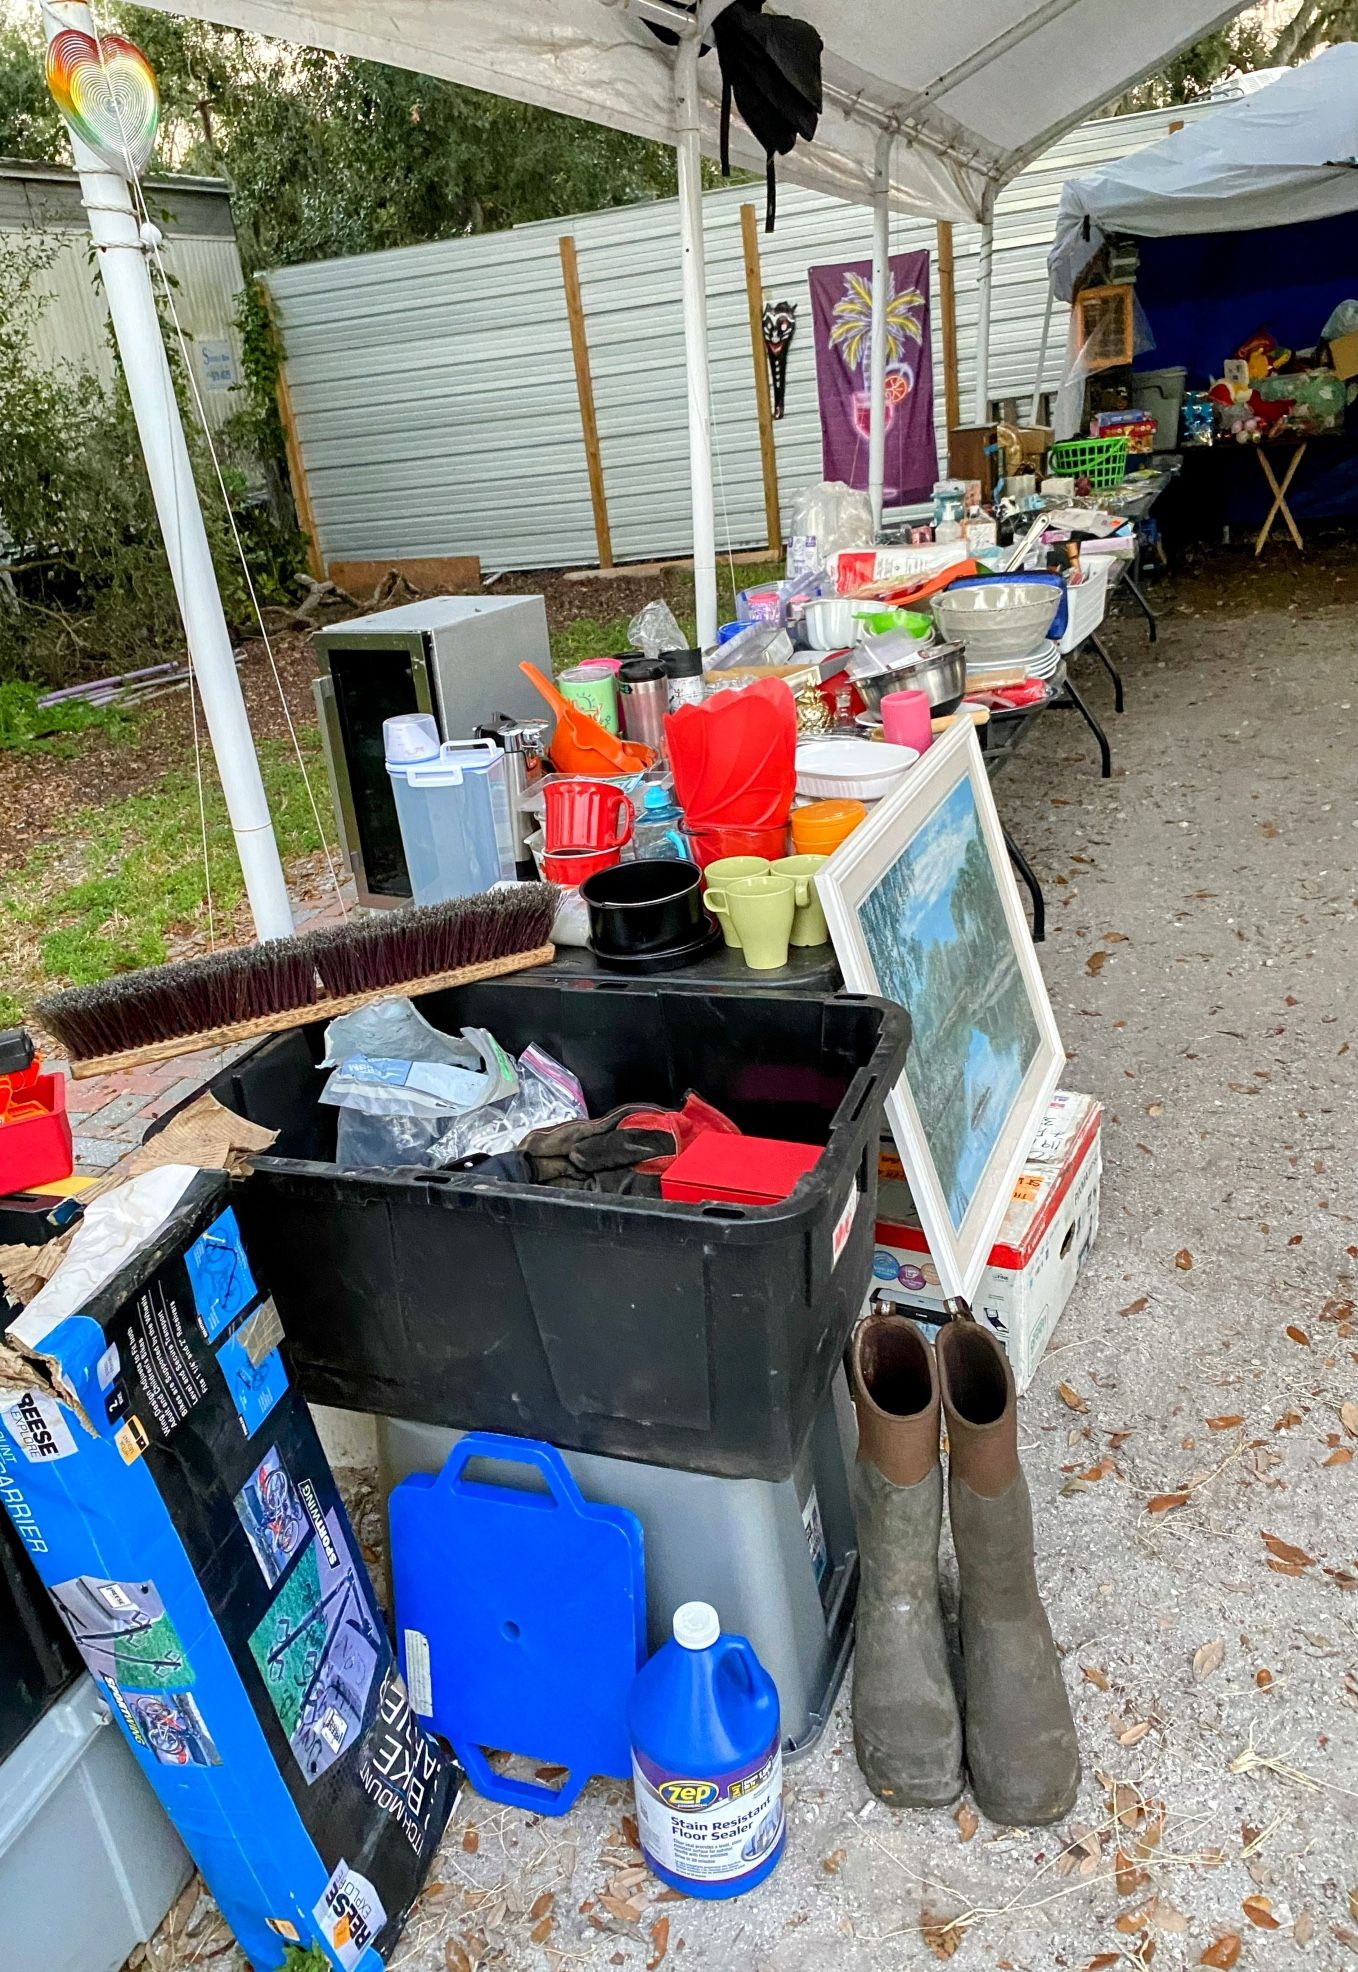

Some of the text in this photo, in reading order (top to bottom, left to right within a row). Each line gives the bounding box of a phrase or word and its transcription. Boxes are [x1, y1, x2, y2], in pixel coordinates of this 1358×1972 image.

[140, 1294, 152, 1324] Wheels
[126, 1327, 136, 1345] both
[154, 1345, 172, 1382] Supported
[157, 1310, 198, 1405] Level and Secure Transport
[183, 1345, 192, 1359] and
[136, 1362, 150, 1388] Adjusts
[137, 1337, 177, 1427] Adult and Children's Bikes
[169, 1382, 178, 1395] are
[197, 1378, 208, 1393] Fits
[108, 1399, 118, 1412] 2
[145, 1389, 161, 1416] Design
[174, 1394, 188, 1417] Bikes
[10, 1412, 41, 1458] EXPLORE
[158, 1414, 171, 1437] Wing
[301, 1484, 338, 1565] SPORTWING
[104, 1678, 145, 1744] SPORTWING
[358, 1761, 404, 1820] MOUNT
[671, 1796, 771, 1831] Stain Resistant
[671, 1821, 753, 1841] Floor Sealer
